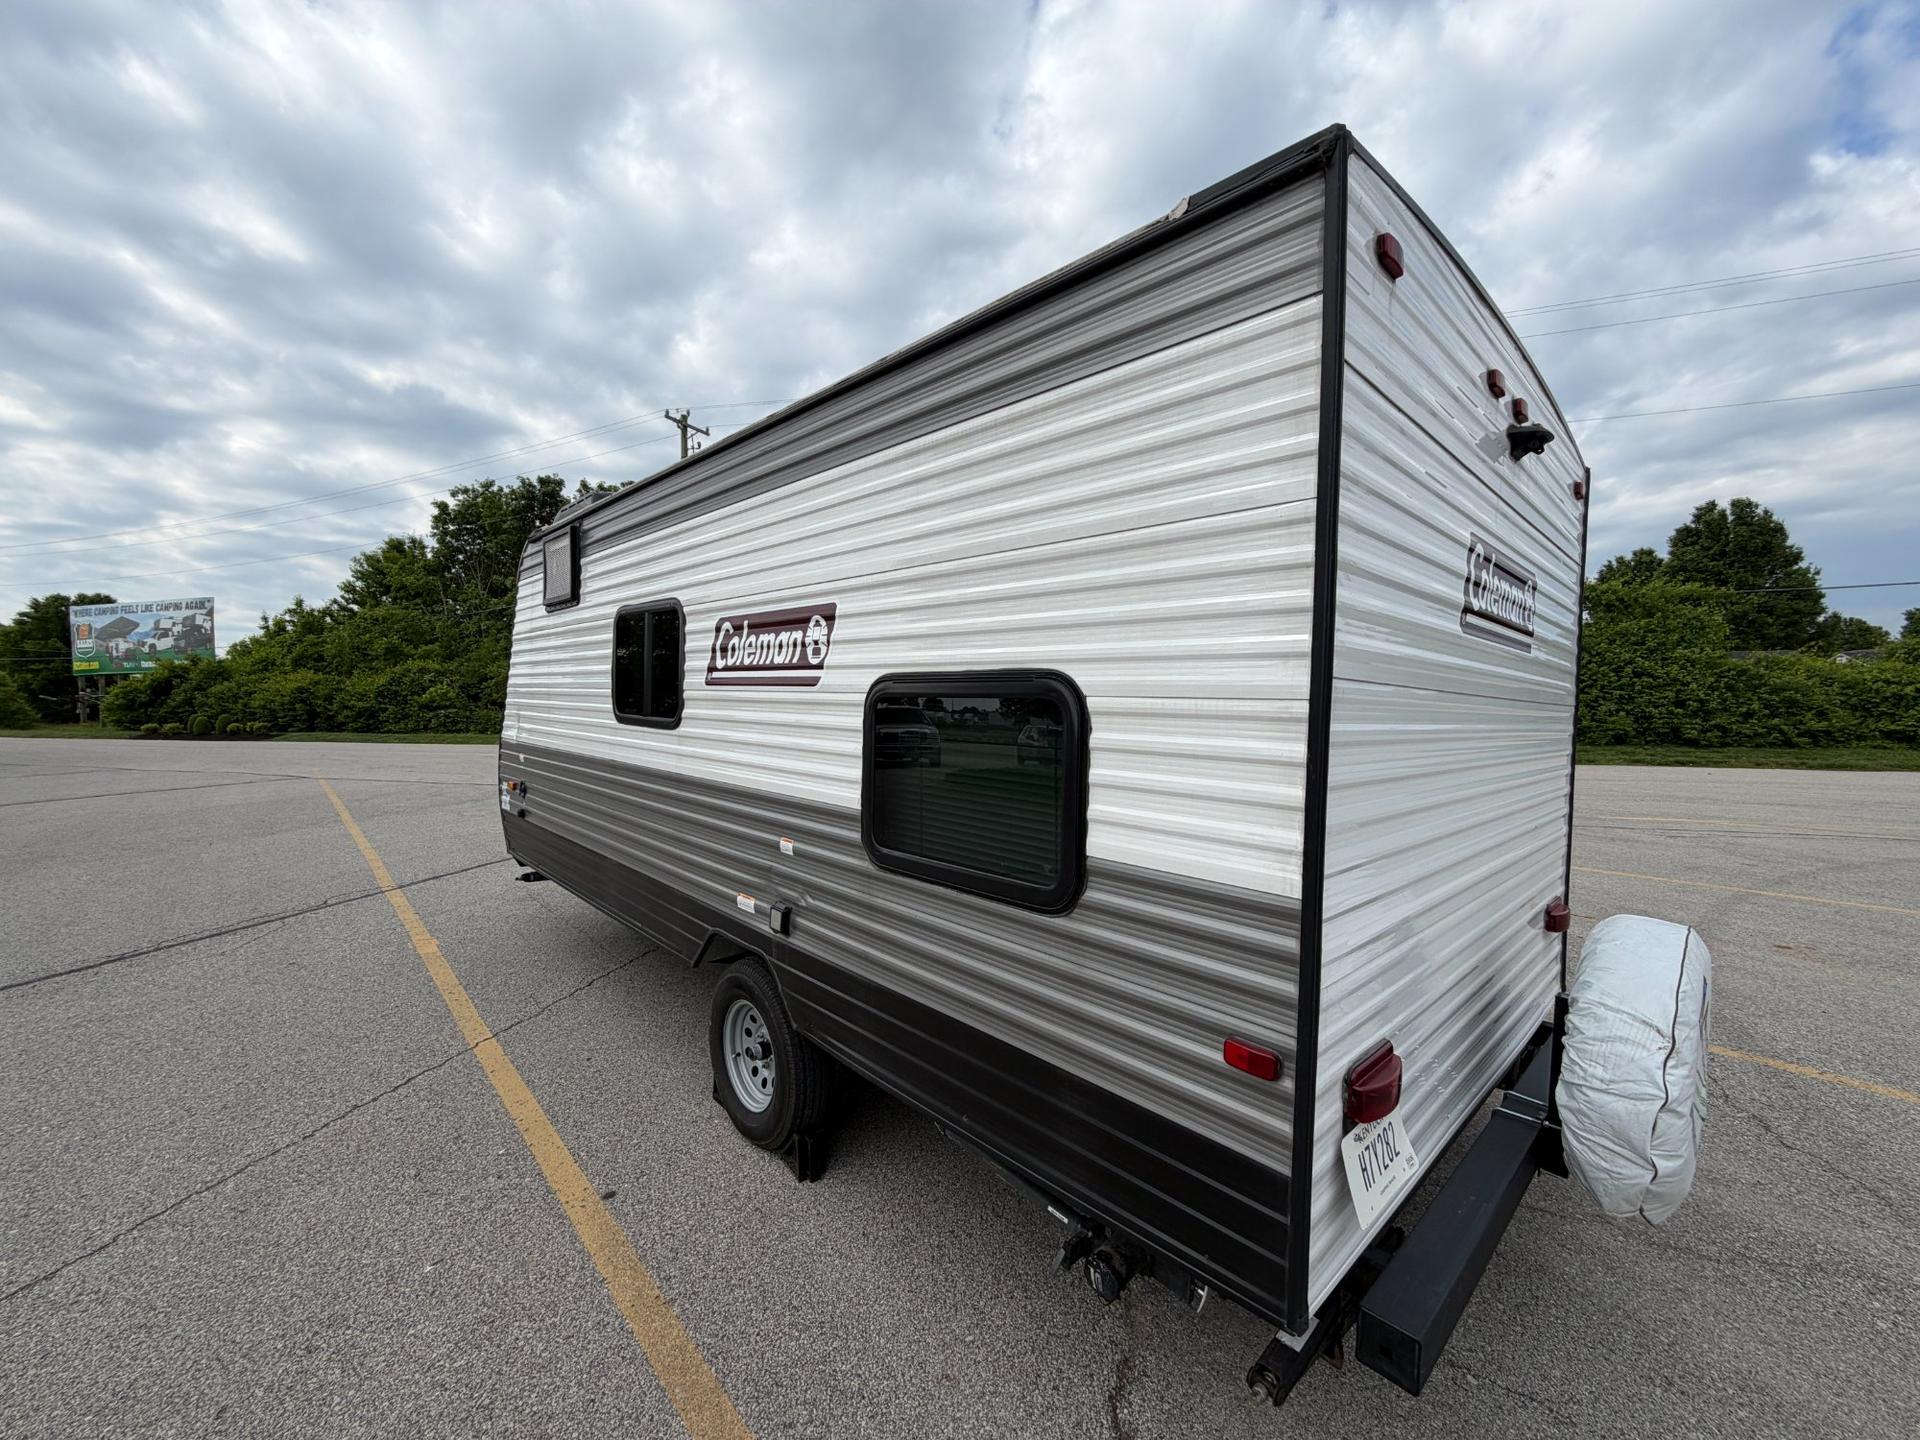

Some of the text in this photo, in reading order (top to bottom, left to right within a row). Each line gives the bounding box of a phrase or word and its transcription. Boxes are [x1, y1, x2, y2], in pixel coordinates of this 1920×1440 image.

[94, 606, 119, 616] CAMPING
[120, 604, 139, 614] FEELS
[140, 603, 154, 612] LIKE
[155, 602, 182, 612] CAMPING
[1469, 543, 1525, 625] Coleman
[715, 620, 803, 670] Coleman
[1358, 1121, 1400, 1192] H7Y282
